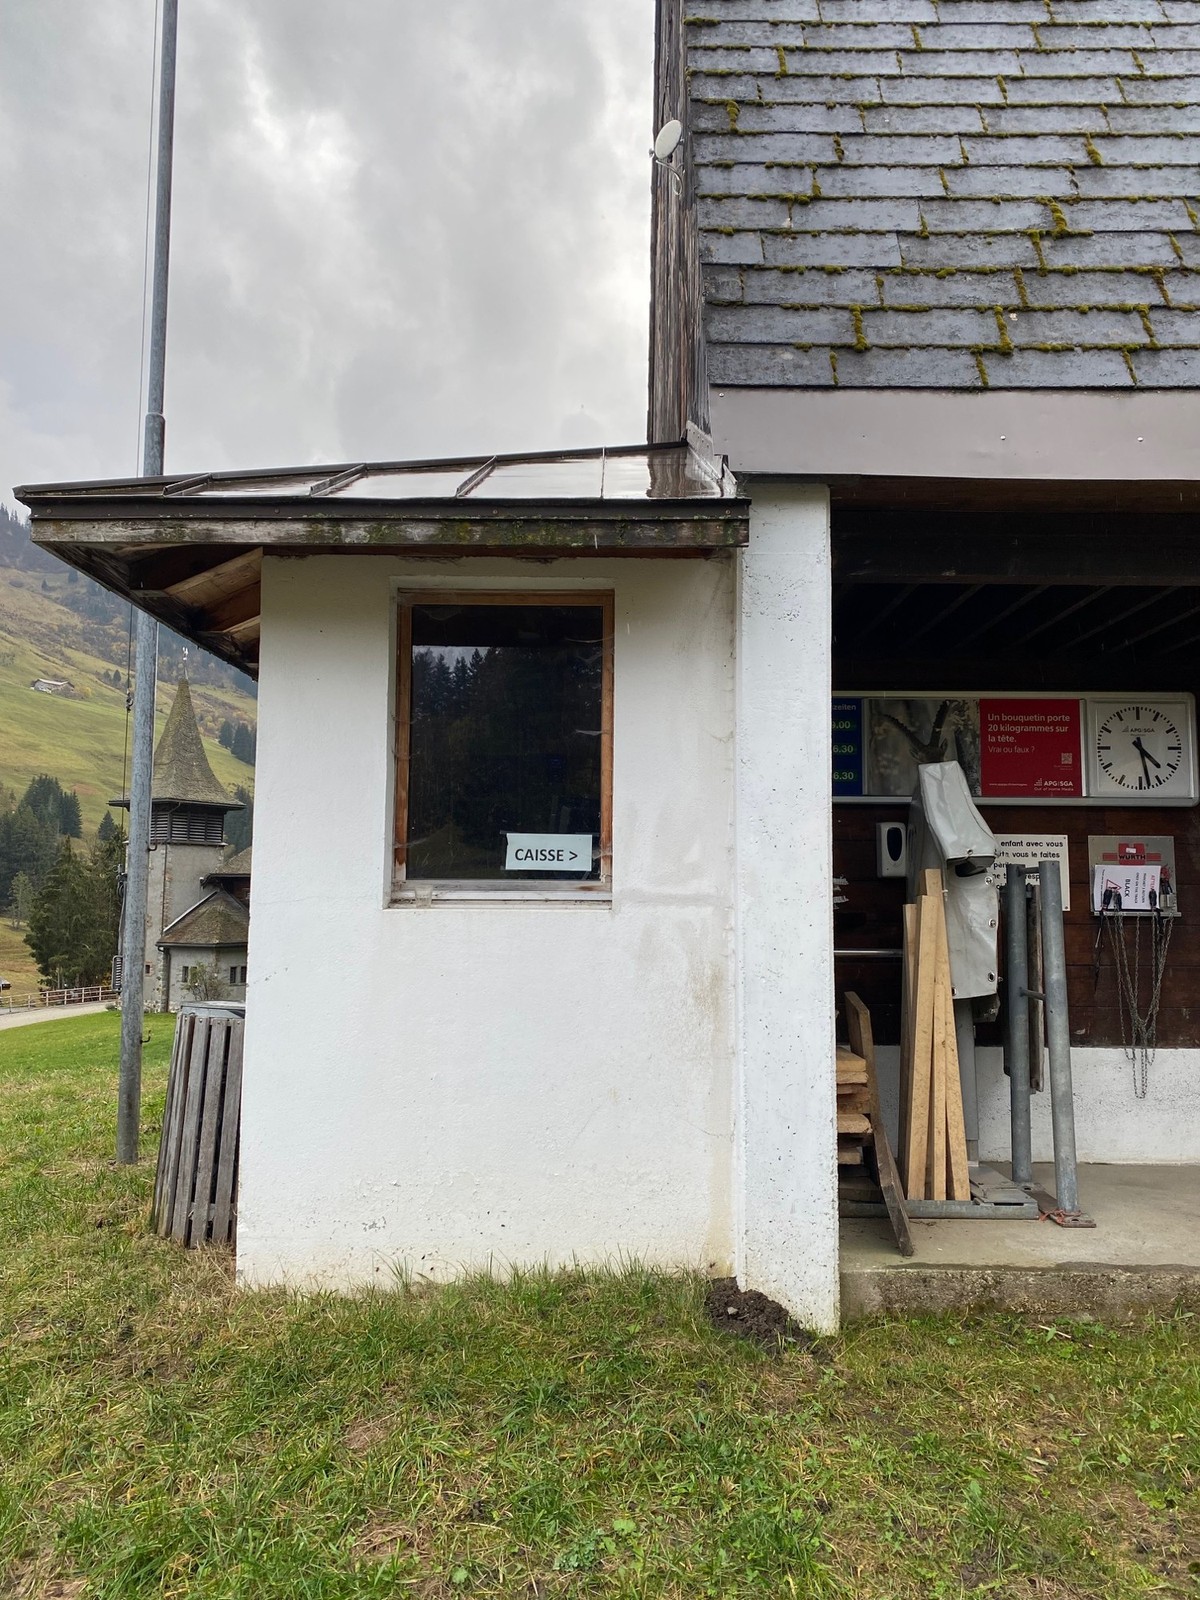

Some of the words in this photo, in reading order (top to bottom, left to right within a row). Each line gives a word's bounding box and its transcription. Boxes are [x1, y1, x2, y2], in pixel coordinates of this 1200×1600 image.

[988, 713, 1000, 721] Un
[1001, 713, 1046, 723] bouquetin
[1047, 714, 1071, 723] porte
[988, 724, 999, 732] 20
[1000, 724, 1054, 733] kilogrammes
[515, 849, 564, 861] CAISSE
